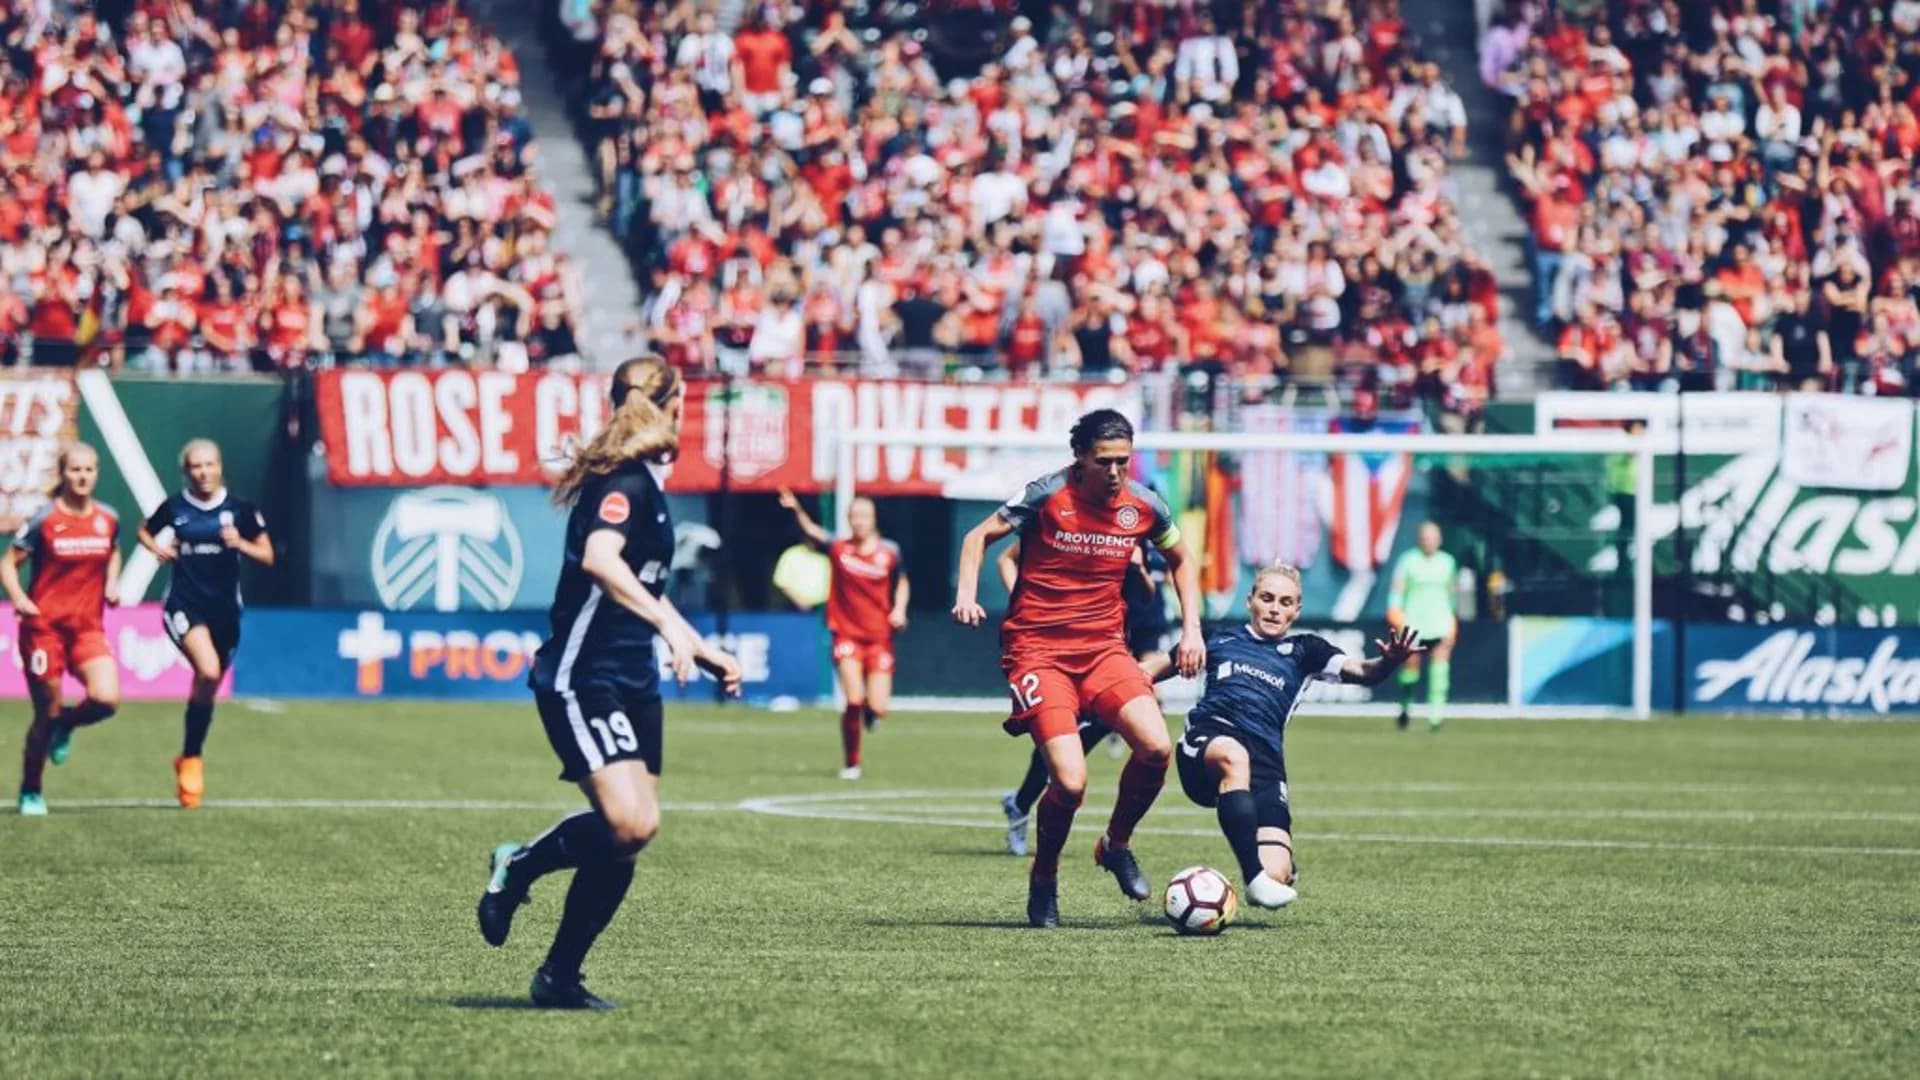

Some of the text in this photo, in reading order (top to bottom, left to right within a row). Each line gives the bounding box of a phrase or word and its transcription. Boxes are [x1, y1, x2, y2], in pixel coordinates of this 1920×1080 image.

[340, 371, 518, 476] ROSE
[1052, 542, 1083, 555] Health
[1092, 547, 1126, 558] Services
[1010, 672, 1043, 711] 12
[1233, 662, 1286, 691] Microsoft
[1695, 628, 1920, 714] Alaska
[590, 710, 638, 756] 19
